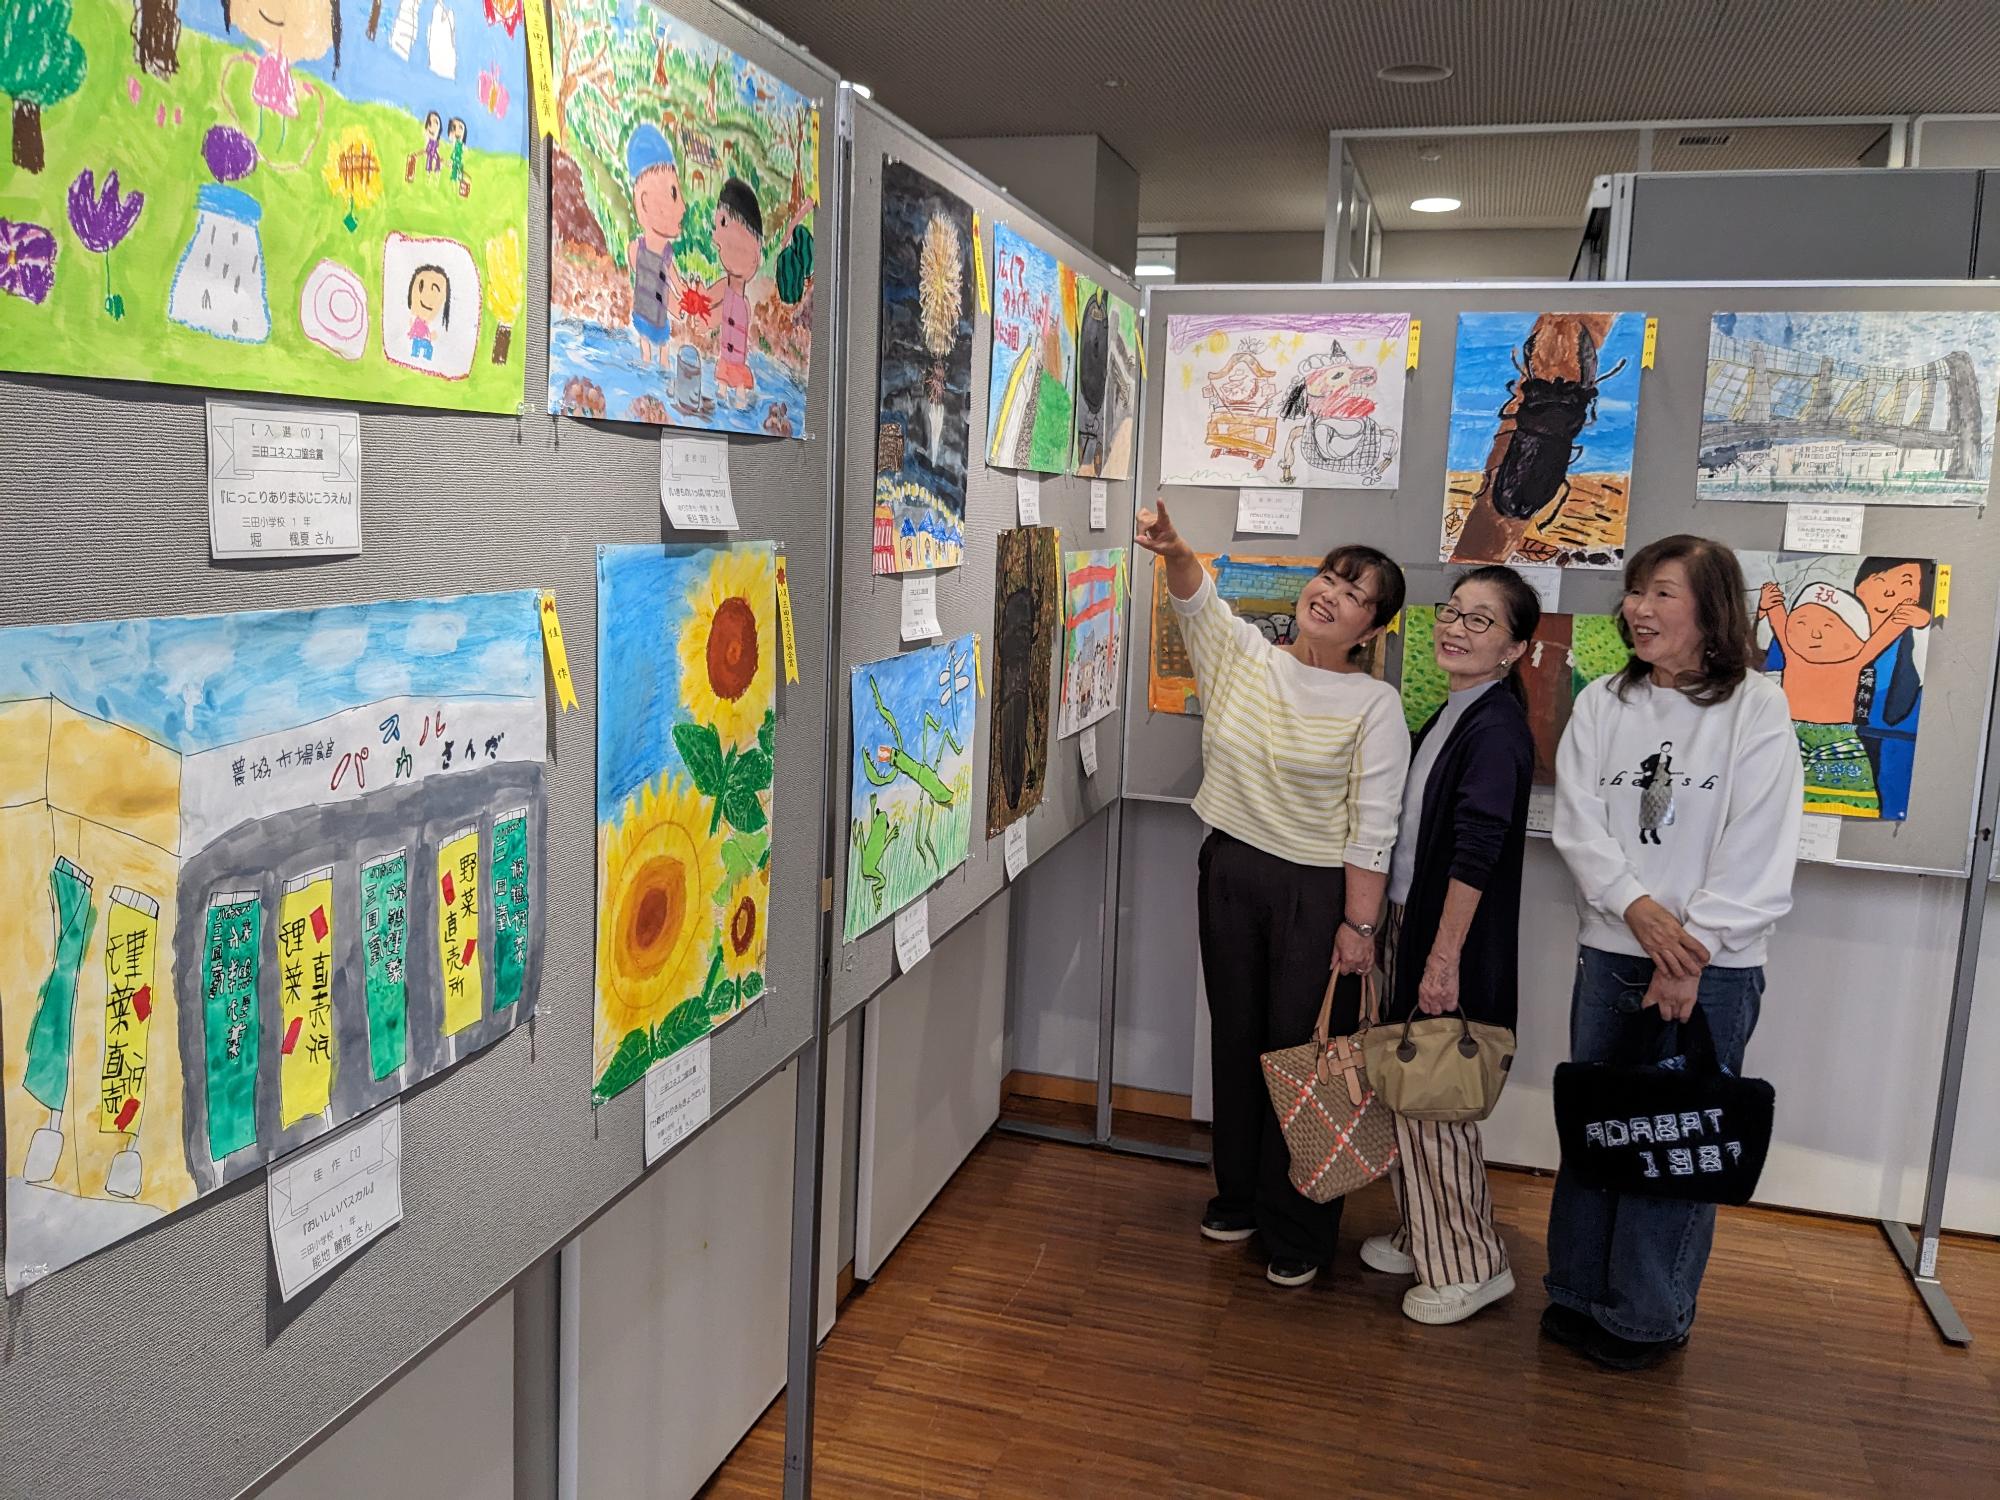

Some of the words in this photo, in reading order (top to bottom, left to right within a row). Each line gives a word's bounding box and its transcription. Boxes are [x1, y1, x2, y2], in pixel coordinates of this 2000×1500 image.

[251, 445, 324, 461] 三田ユネスコ協会賞
[242, 517, 286, 528] 三田小学校
[315, 531, 335, 545] さん
[1814, 586, 1839, 605] 祝
[1600, 771, 1719, 790] cheish
[1586, 1108, 1724, 1148] ADABAT
[356, 1221, 373, 1239] さん
